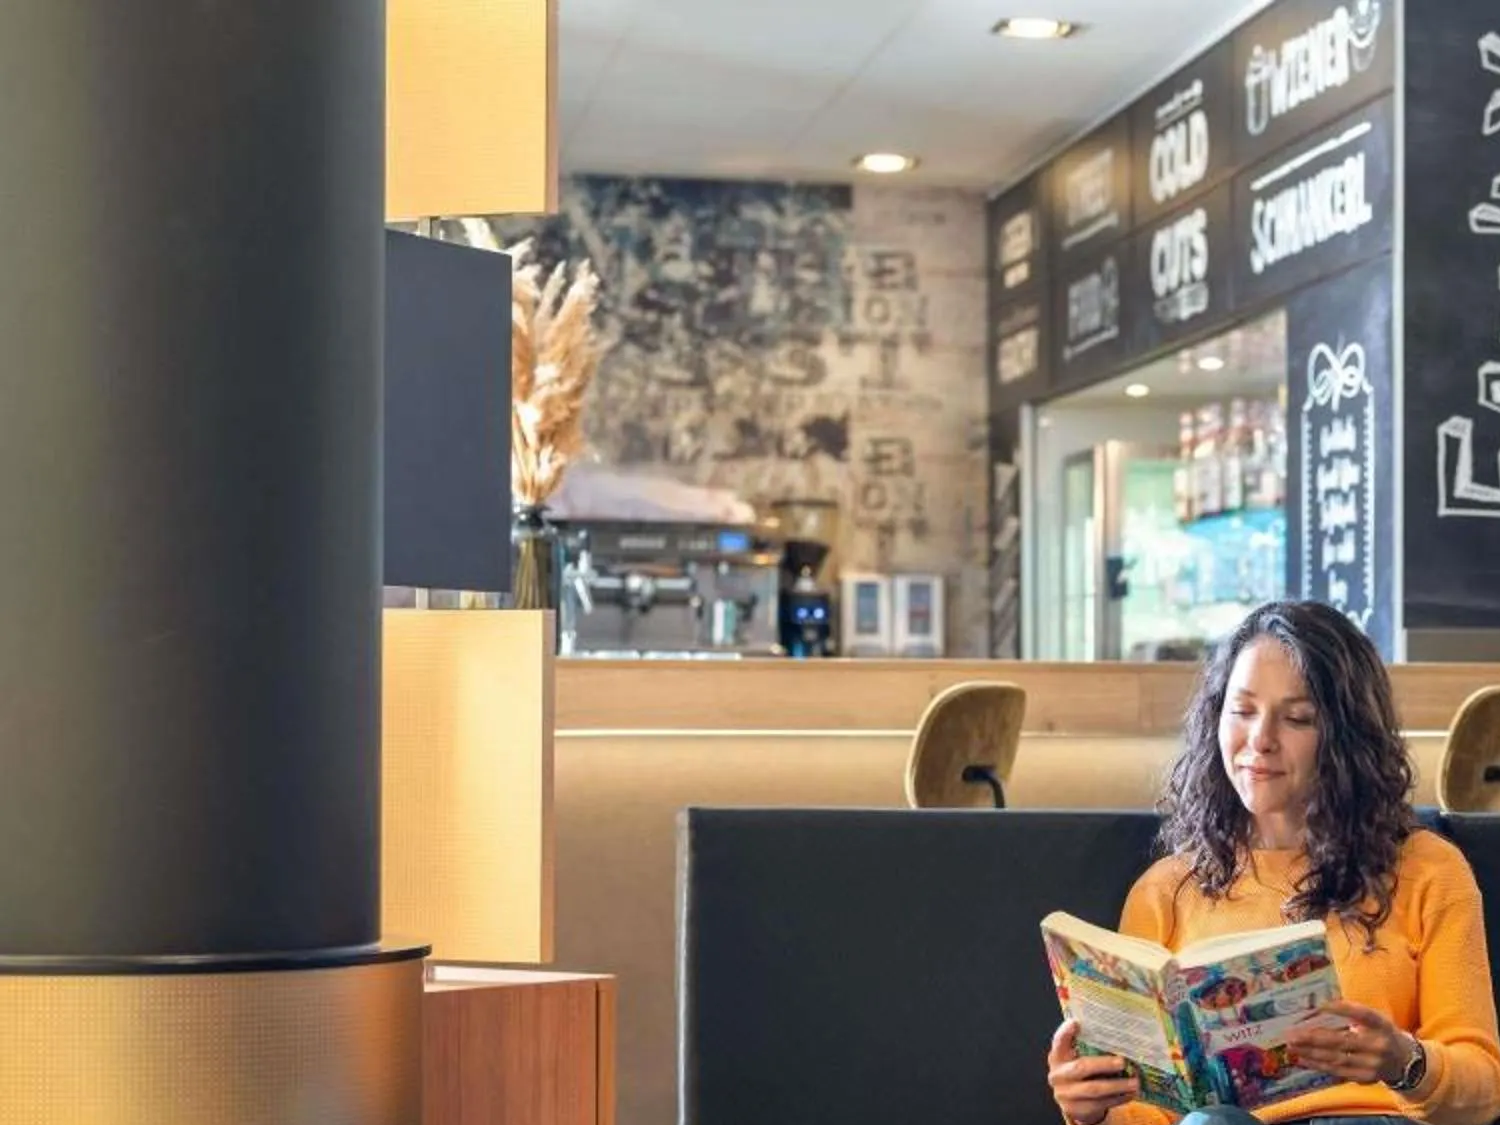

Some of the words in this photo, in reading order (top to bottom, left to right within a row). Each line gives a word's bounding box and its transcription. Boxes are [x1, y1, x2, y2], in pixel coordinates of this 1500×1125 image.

[1150, 109, 1210, 204] COLD
[1150, 208, 1209, 297] CUTS
[1250, 151, 1373, 275] SCHMANKERL
